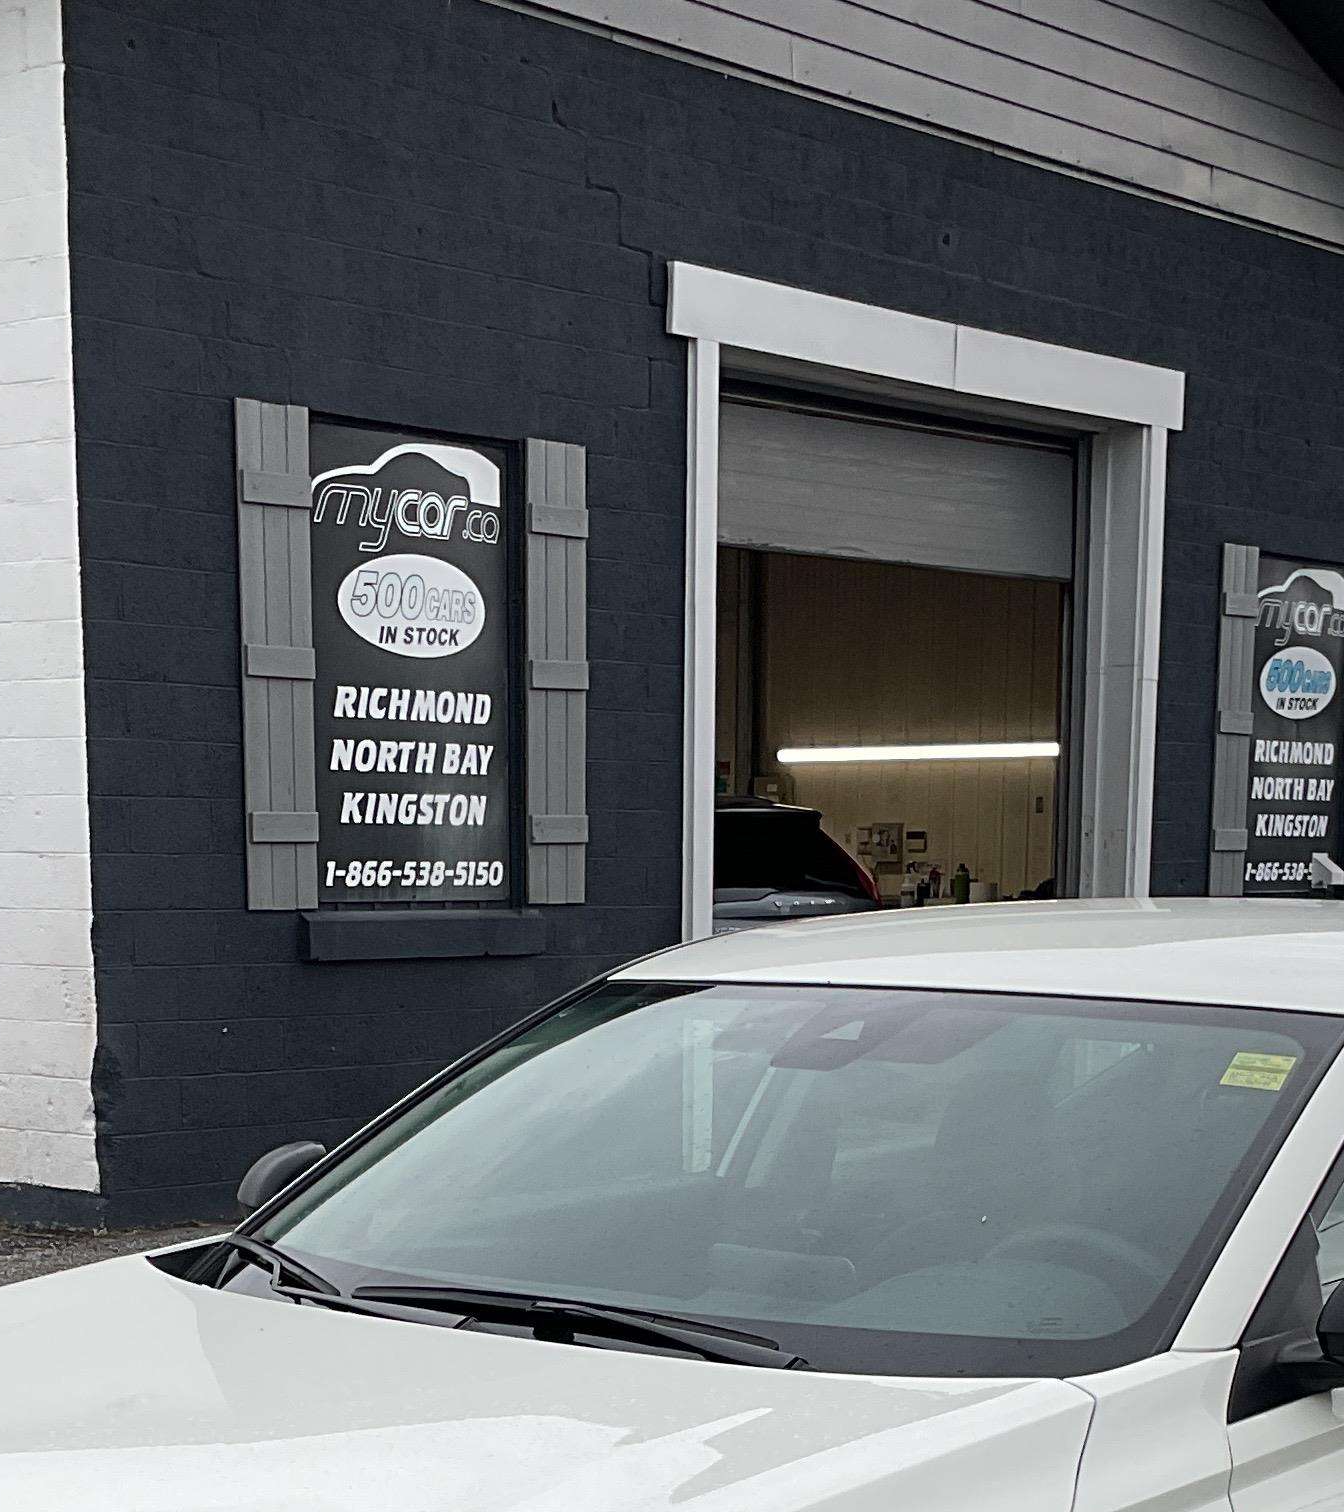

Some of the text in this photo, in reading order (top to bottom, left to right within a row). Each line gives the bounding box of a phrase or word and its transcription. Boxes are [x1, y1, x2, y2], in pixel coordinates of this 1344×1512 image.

[378, 625, 459, 646] IN STOCK
[333, 686, 492, 725] RICHMOND
[1276, 697, 1319, 710] IN STOCK
[330, 739, 494, 775] NORTH BAY
[1254, 739, 1334, 765] RICHMOND
[1251, 777, 1334, 801] NORTH BAY
[340, 792, 487, 826] KINGSTON
[1255, 813, 1329, 837] KINGSTON
[325, 861, 504, 887] 1-866-538-5150
